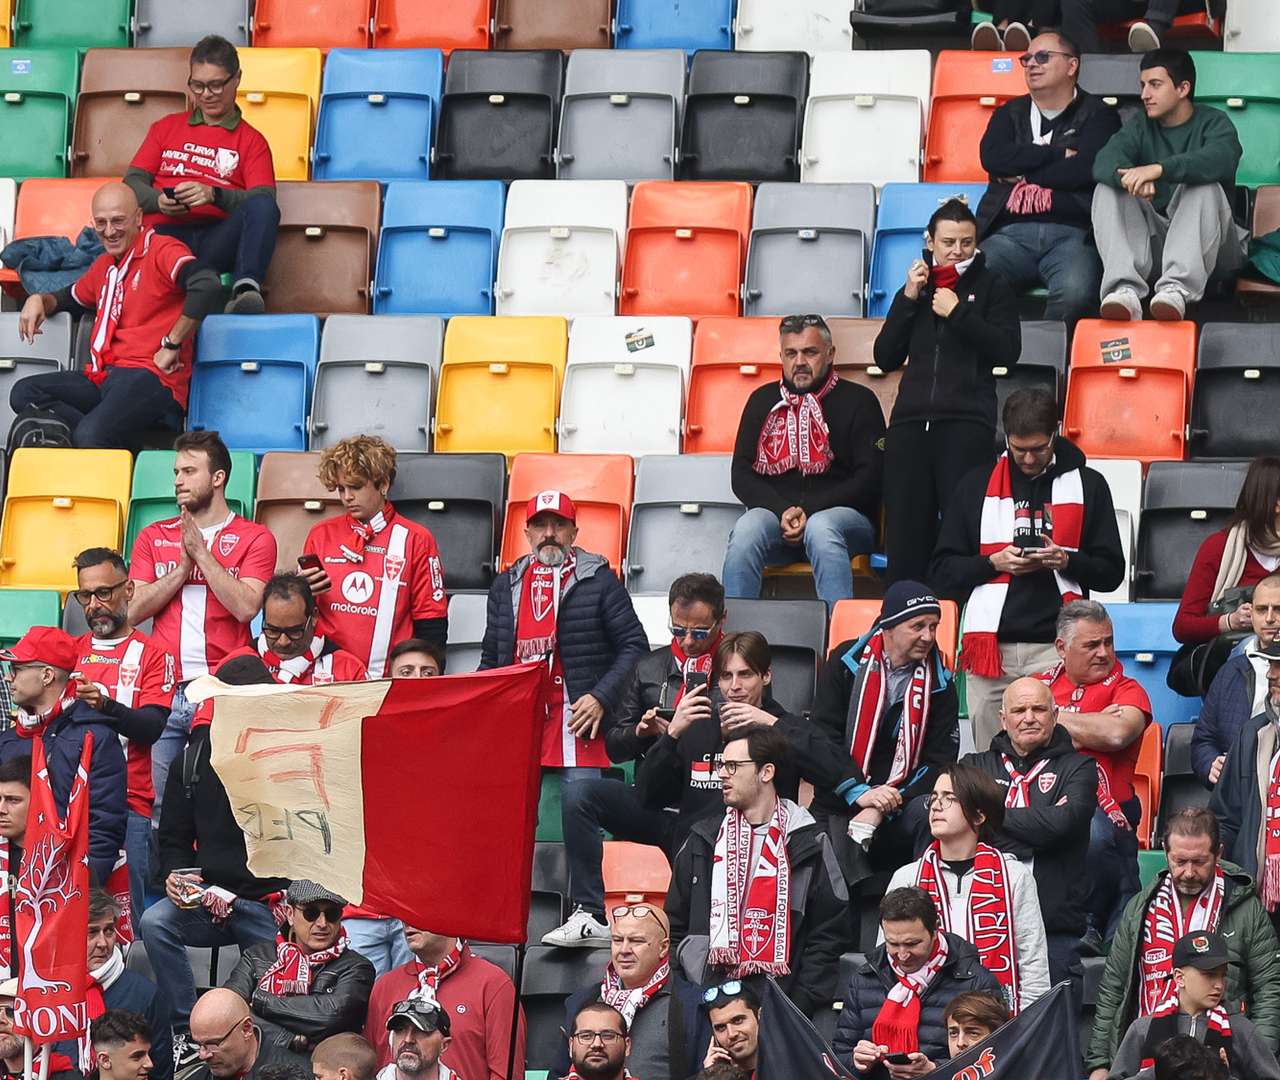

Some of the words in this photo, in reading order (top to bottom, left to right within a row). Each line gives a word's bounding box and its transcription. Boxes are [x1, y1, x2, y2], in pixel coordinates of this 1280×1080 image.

[184, 143, 216, 158] CURVA
[331, 601, 377, 616] motorola
[777, 898, 787, 930] FORZA
[972, 869, 1010, 972] CURVA
[775, 932, 785, 960] BAGAI
